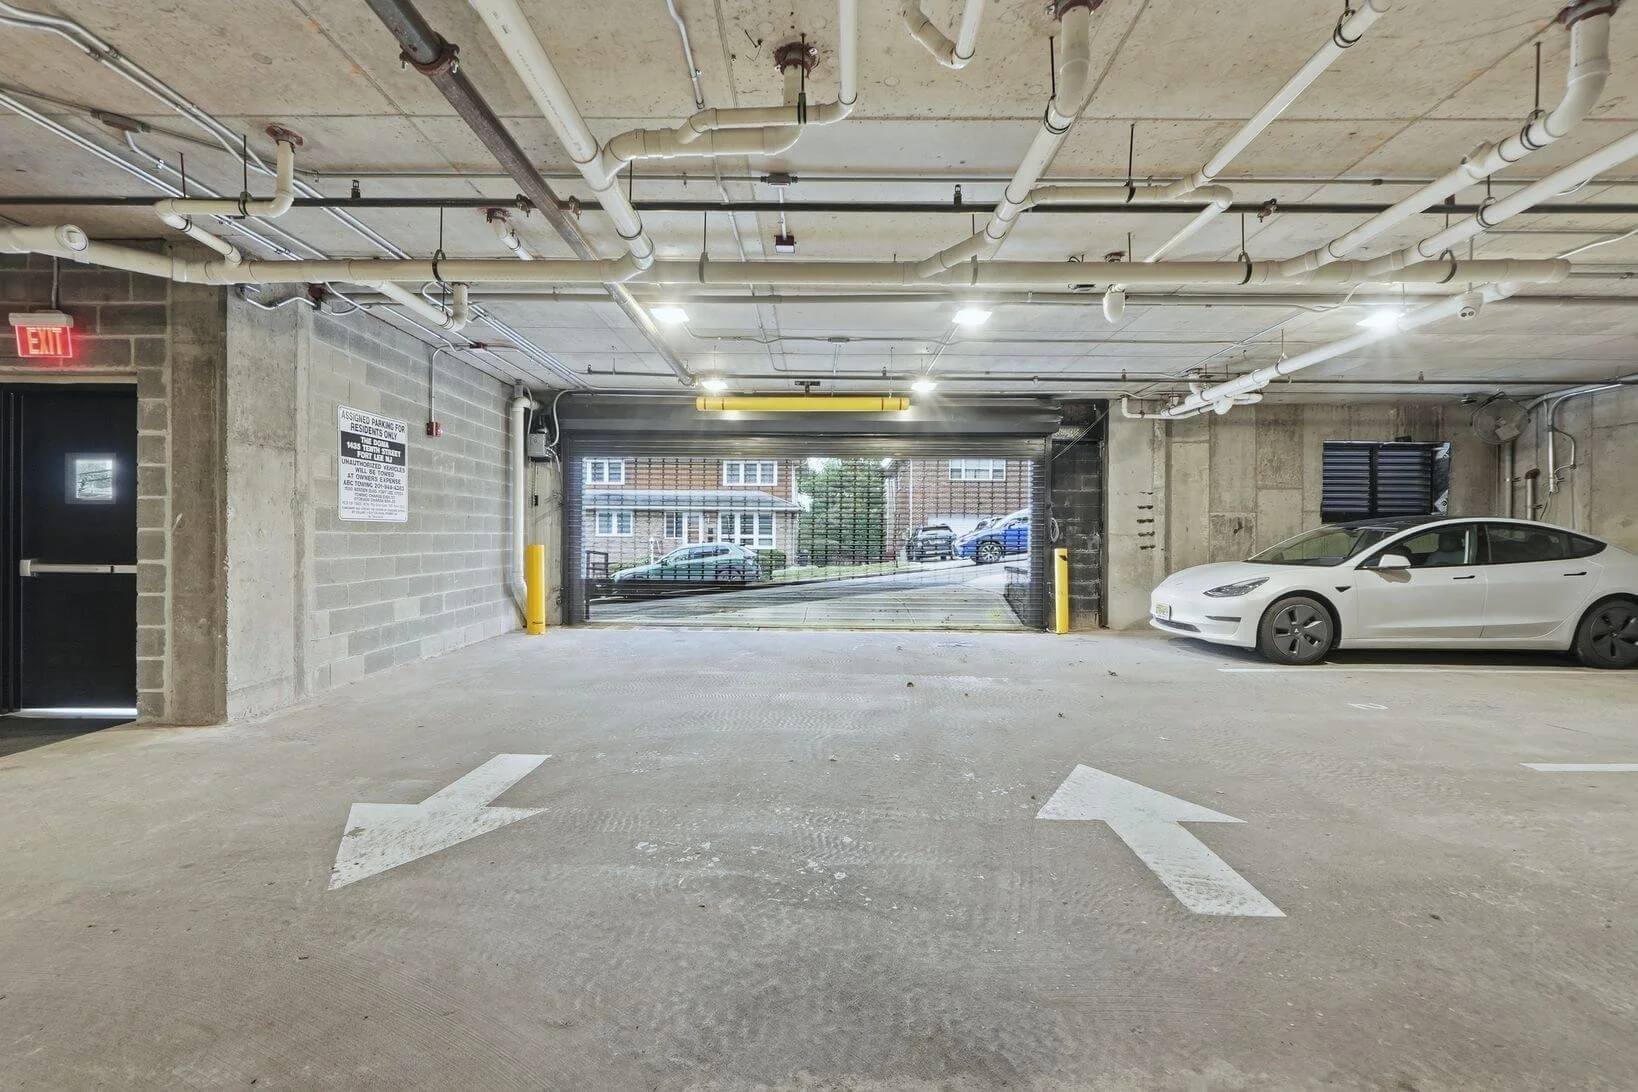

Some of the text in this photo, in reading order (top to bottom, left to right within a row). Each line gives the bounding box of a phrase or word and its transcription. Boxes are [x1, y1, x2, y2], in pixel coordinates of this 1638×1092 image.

[26, 327, 63, 354] EXIT
[341, 410, 406, 433] ASSIGNED PARKING FOR
[350, 422, 398, 440] RESIDENTS ONLY
[360, 436, 372, 445] THE
[357, 451, 372, 460] FORT
[373, 453, 384, 462] LEE
[362, 444, 381, 454] TENTH
[381, 448, 401, 458] STREET
[341, 458, 406, 474] UNAUTHORIZED VEHICLES
[355, 473, 378, 482] OWNERS
[379, 477, 401, 485] EXPENSE
[377, 470, 394, 478] TOWED
[354, 480, 373, 488] TOWING
